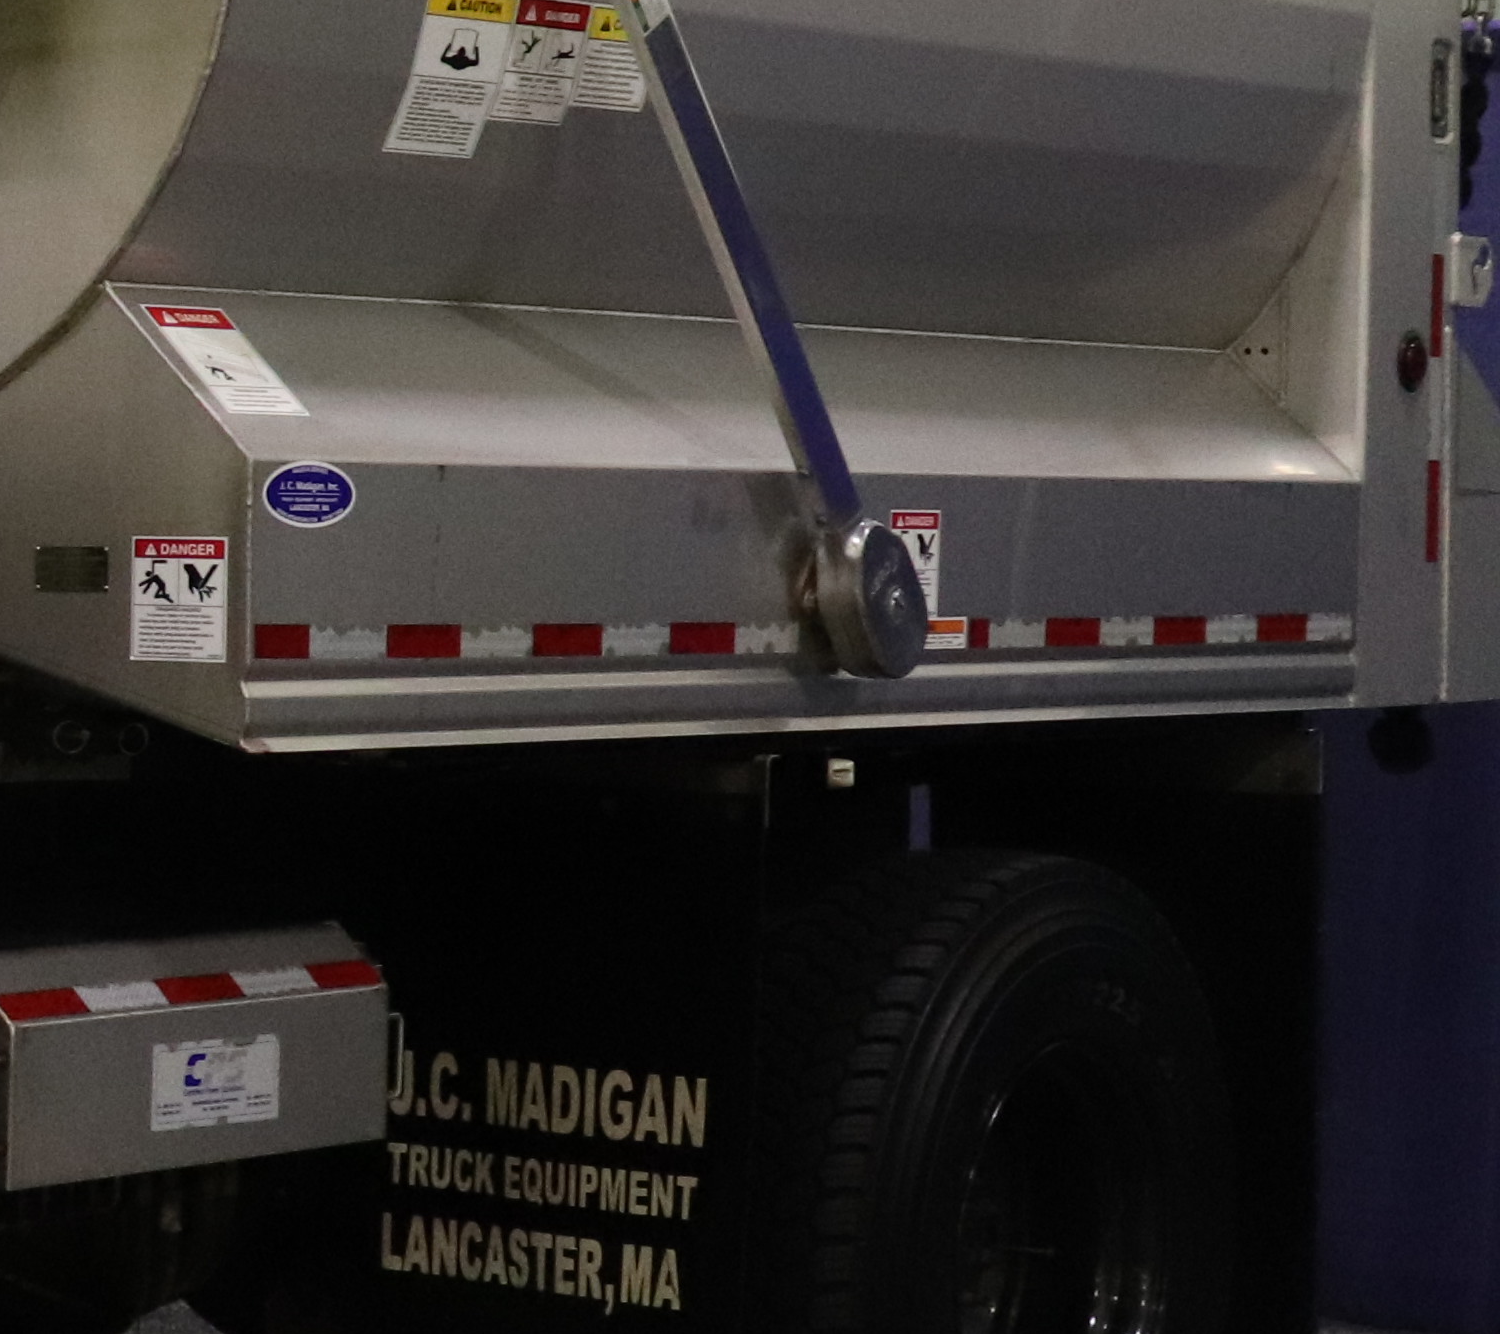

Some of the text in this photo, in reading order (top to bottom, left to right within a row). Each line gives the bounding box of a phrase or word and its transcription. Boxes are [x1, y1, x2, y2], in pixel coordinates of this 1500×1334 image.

[459, 0, 503, 15] CAUTION
[160, 543, 215, 556] DANGER
[389, 1049, 708, 1149] J.C. MADIGAN
[387, 1141, 699, 1221] TRUCK EQUIPMENT
